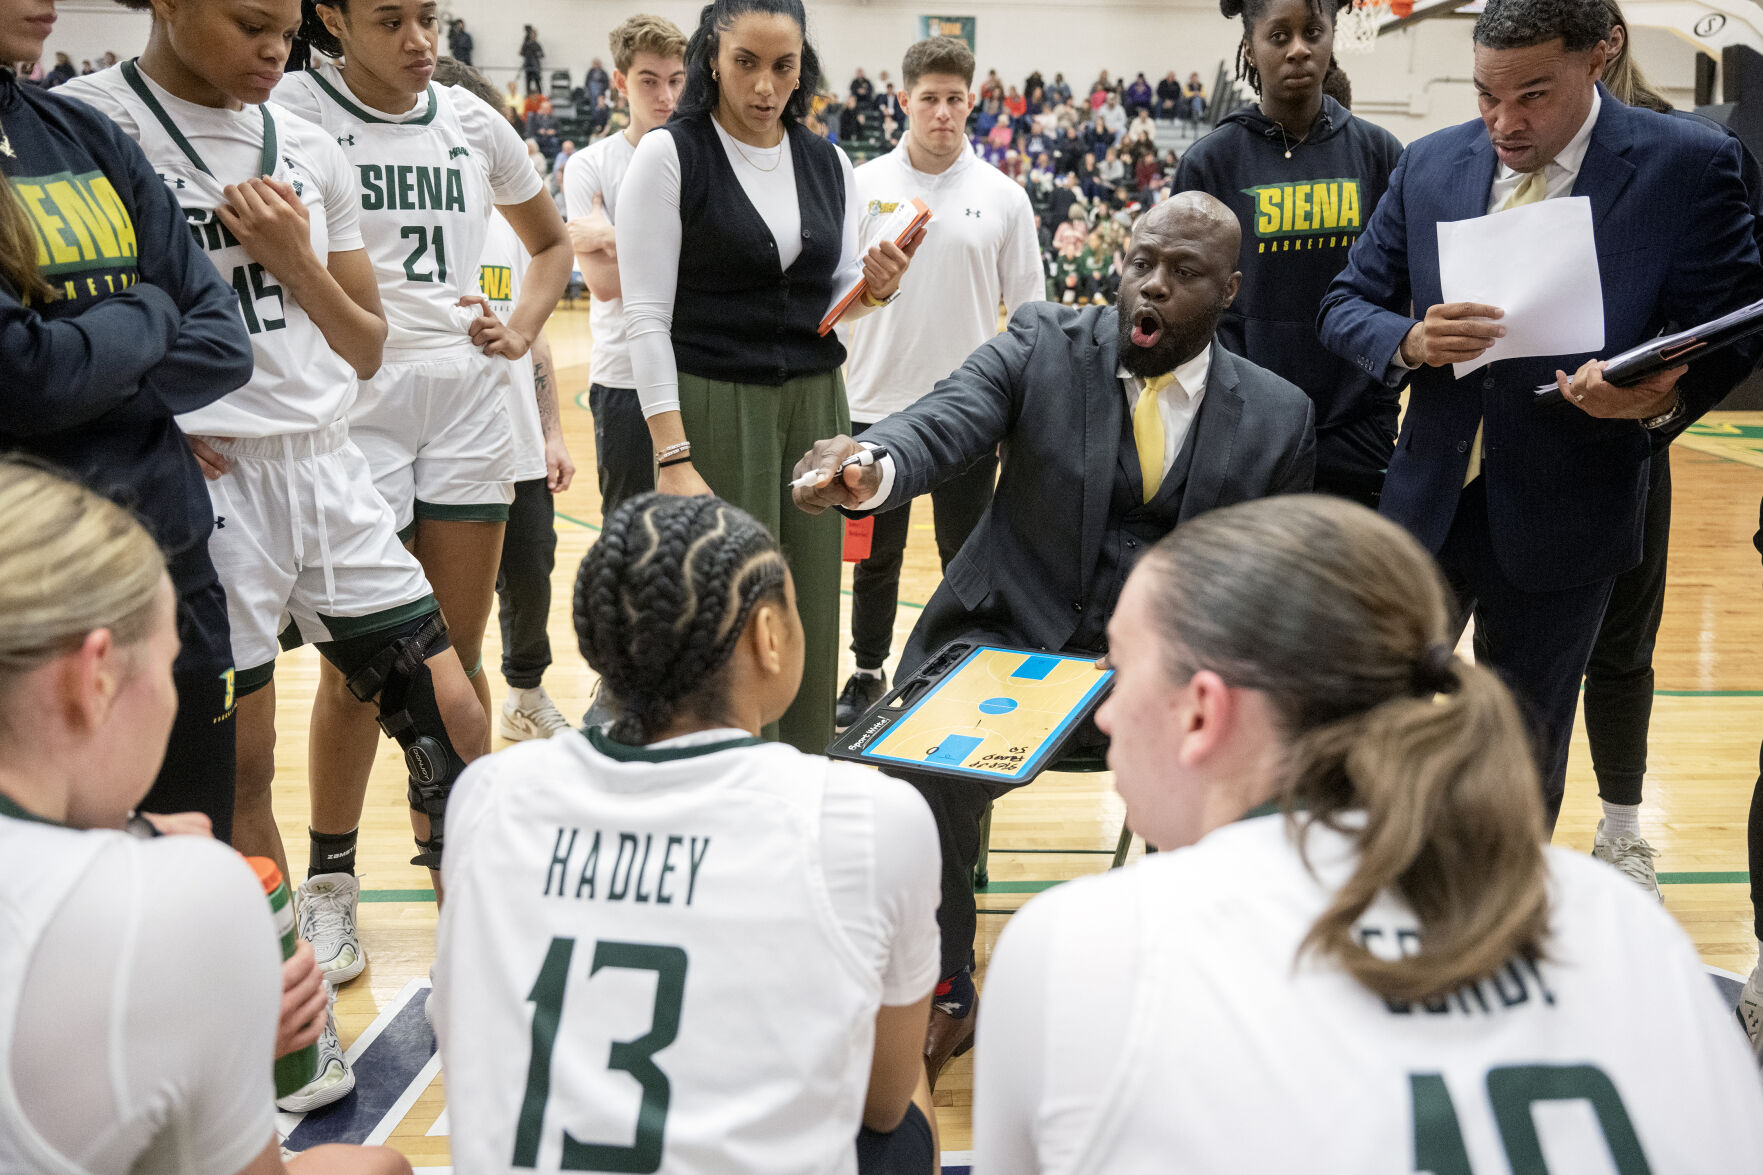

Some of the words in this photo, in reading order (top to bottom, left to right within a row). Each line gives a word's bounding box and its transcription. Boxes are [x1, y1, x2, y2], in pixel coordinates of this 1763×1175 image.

[355, 165, 466, 213] SIENA
[1256, 182, 1360, 233] SIENA
[9, 177, 138, 267] IENA
[400, 226, 447, 284] 21
[232, 262, 286, 334] 15
[412, 748, 430, 780] DONJOY
[847, 733, 870, 751] Sport
[543, 828, 711, 906] HADLEY
[511, 936, 688, 1174] 13
